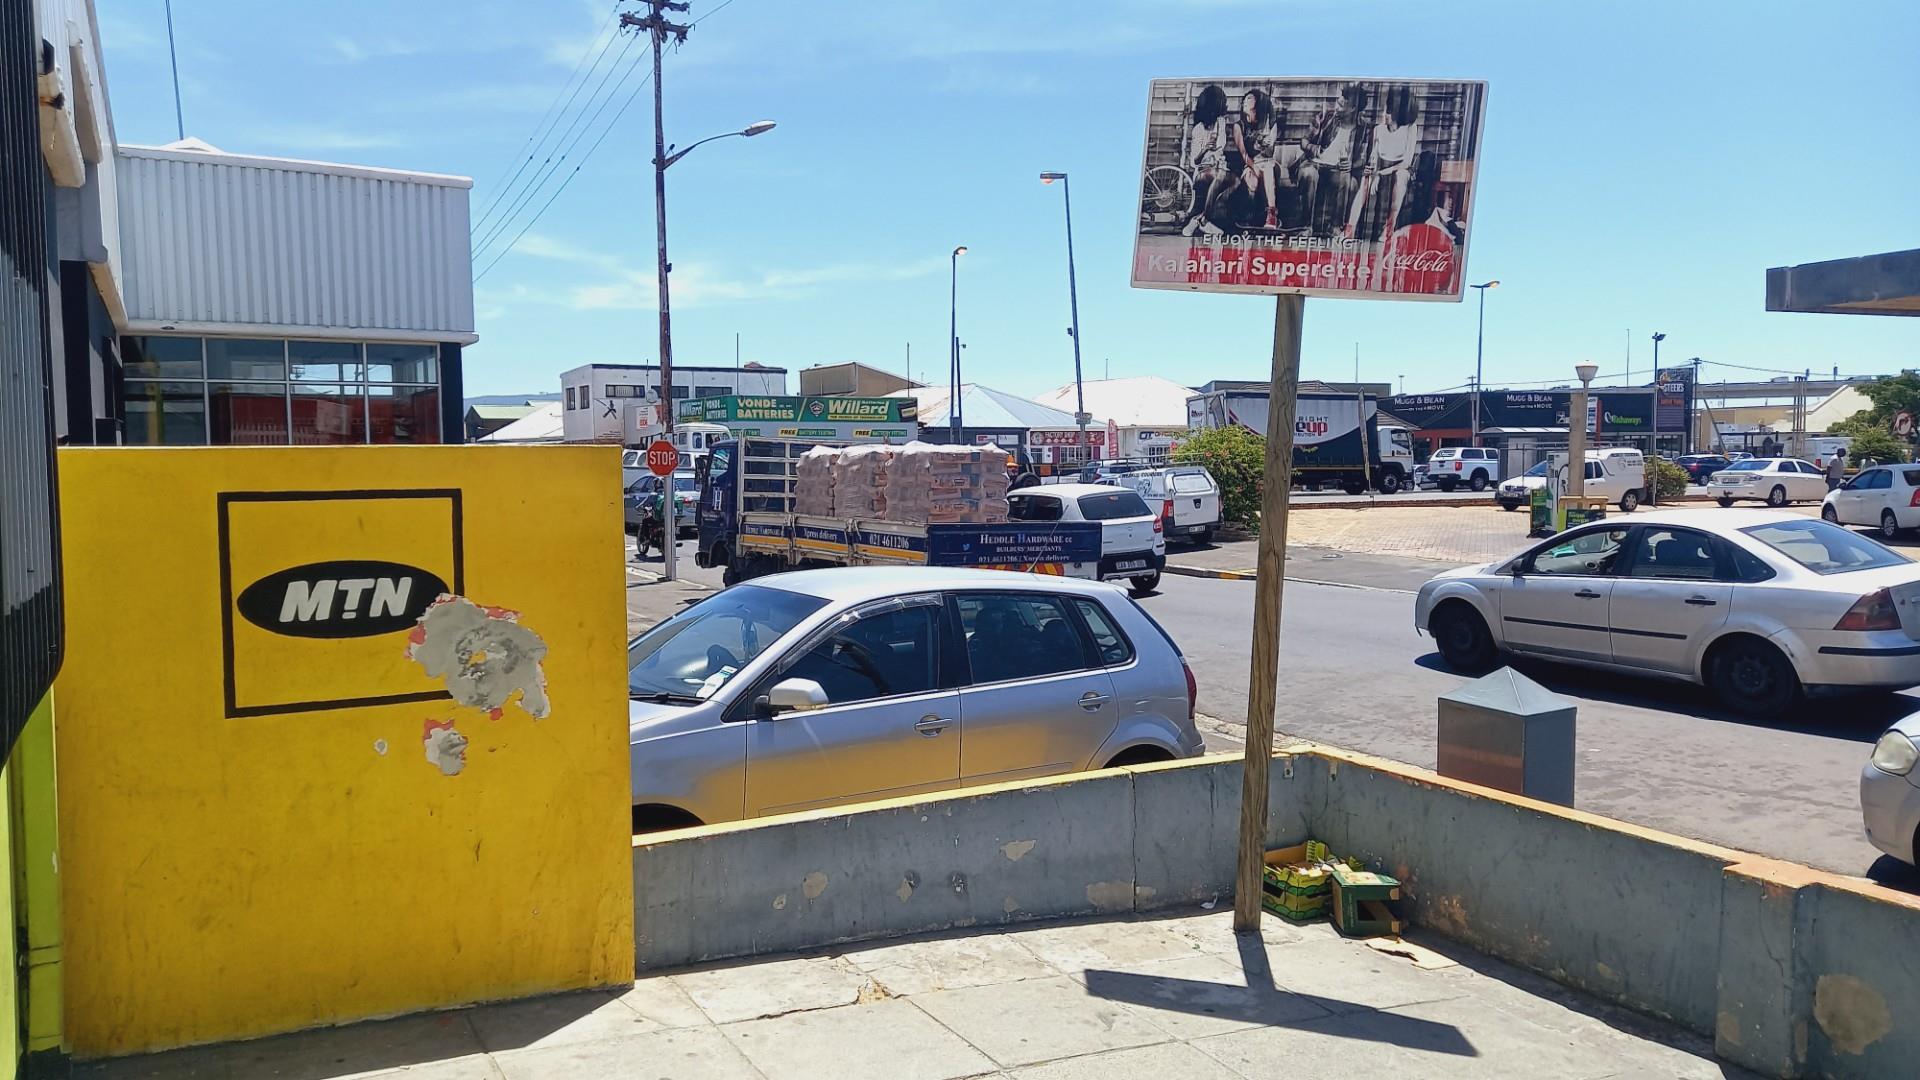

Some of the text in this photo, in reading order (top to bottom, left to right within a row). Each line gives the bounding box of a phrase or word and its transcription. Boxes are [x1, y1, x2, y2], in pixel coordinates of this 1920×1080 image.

[1203, 233, 1252, 247] ENJOY
[1255, 236, 1283, 247] THE
[1149, 254, 1371, 280] Kalahari Superette
[1382, 250, 1451, 273] Coca-Cola
[1663, 383, 1685, 393] STEERS
[737, 398, 777, 408] VONDE
[828, 399, 890, 414] Willard
[737, 409, 794, 419] BATTERIES
[1296, 422, 1329, 436] eup
[650, 451, 676, 466] STOP
[869, 533, 910, 549] 021 4611206
[980, 533, 1015, 544] HEDDLE
[1017, 533, 1064, 544] HARDWARE
[279, 576, 413, 623] MTN
